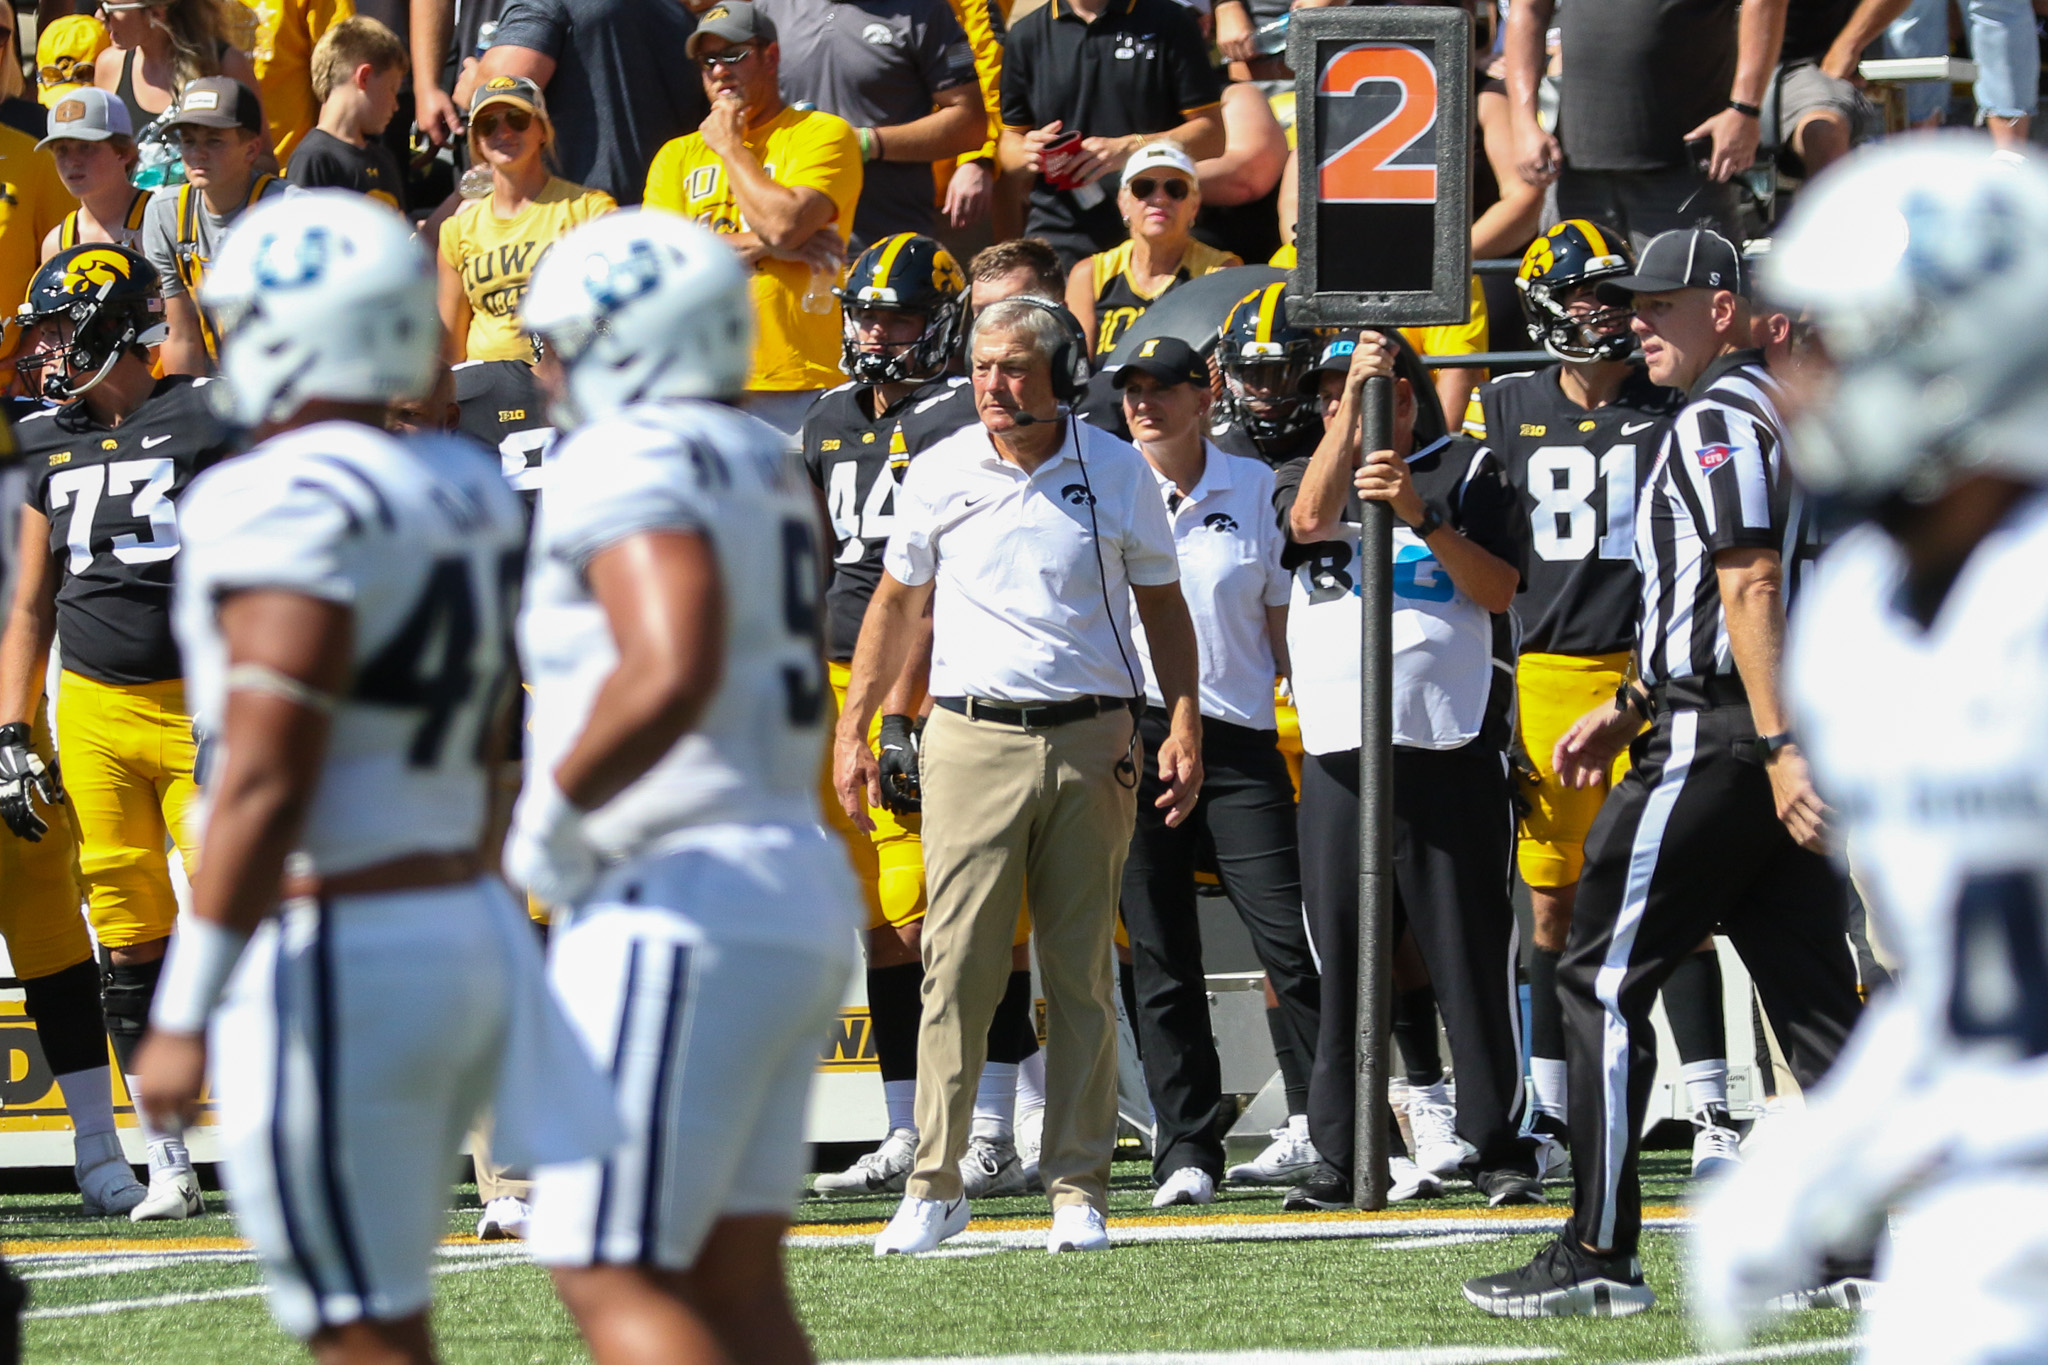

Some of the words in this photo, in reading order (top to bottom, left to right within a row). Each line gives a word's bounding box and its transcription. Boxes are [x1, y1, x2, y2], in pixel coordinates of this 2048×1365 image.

[1316, 42, 1438, 204] 2
[1138, 339, 1160, 358] I
[48, 457, 181, 576] 73
[1526, 443, 1637, 562] 81
